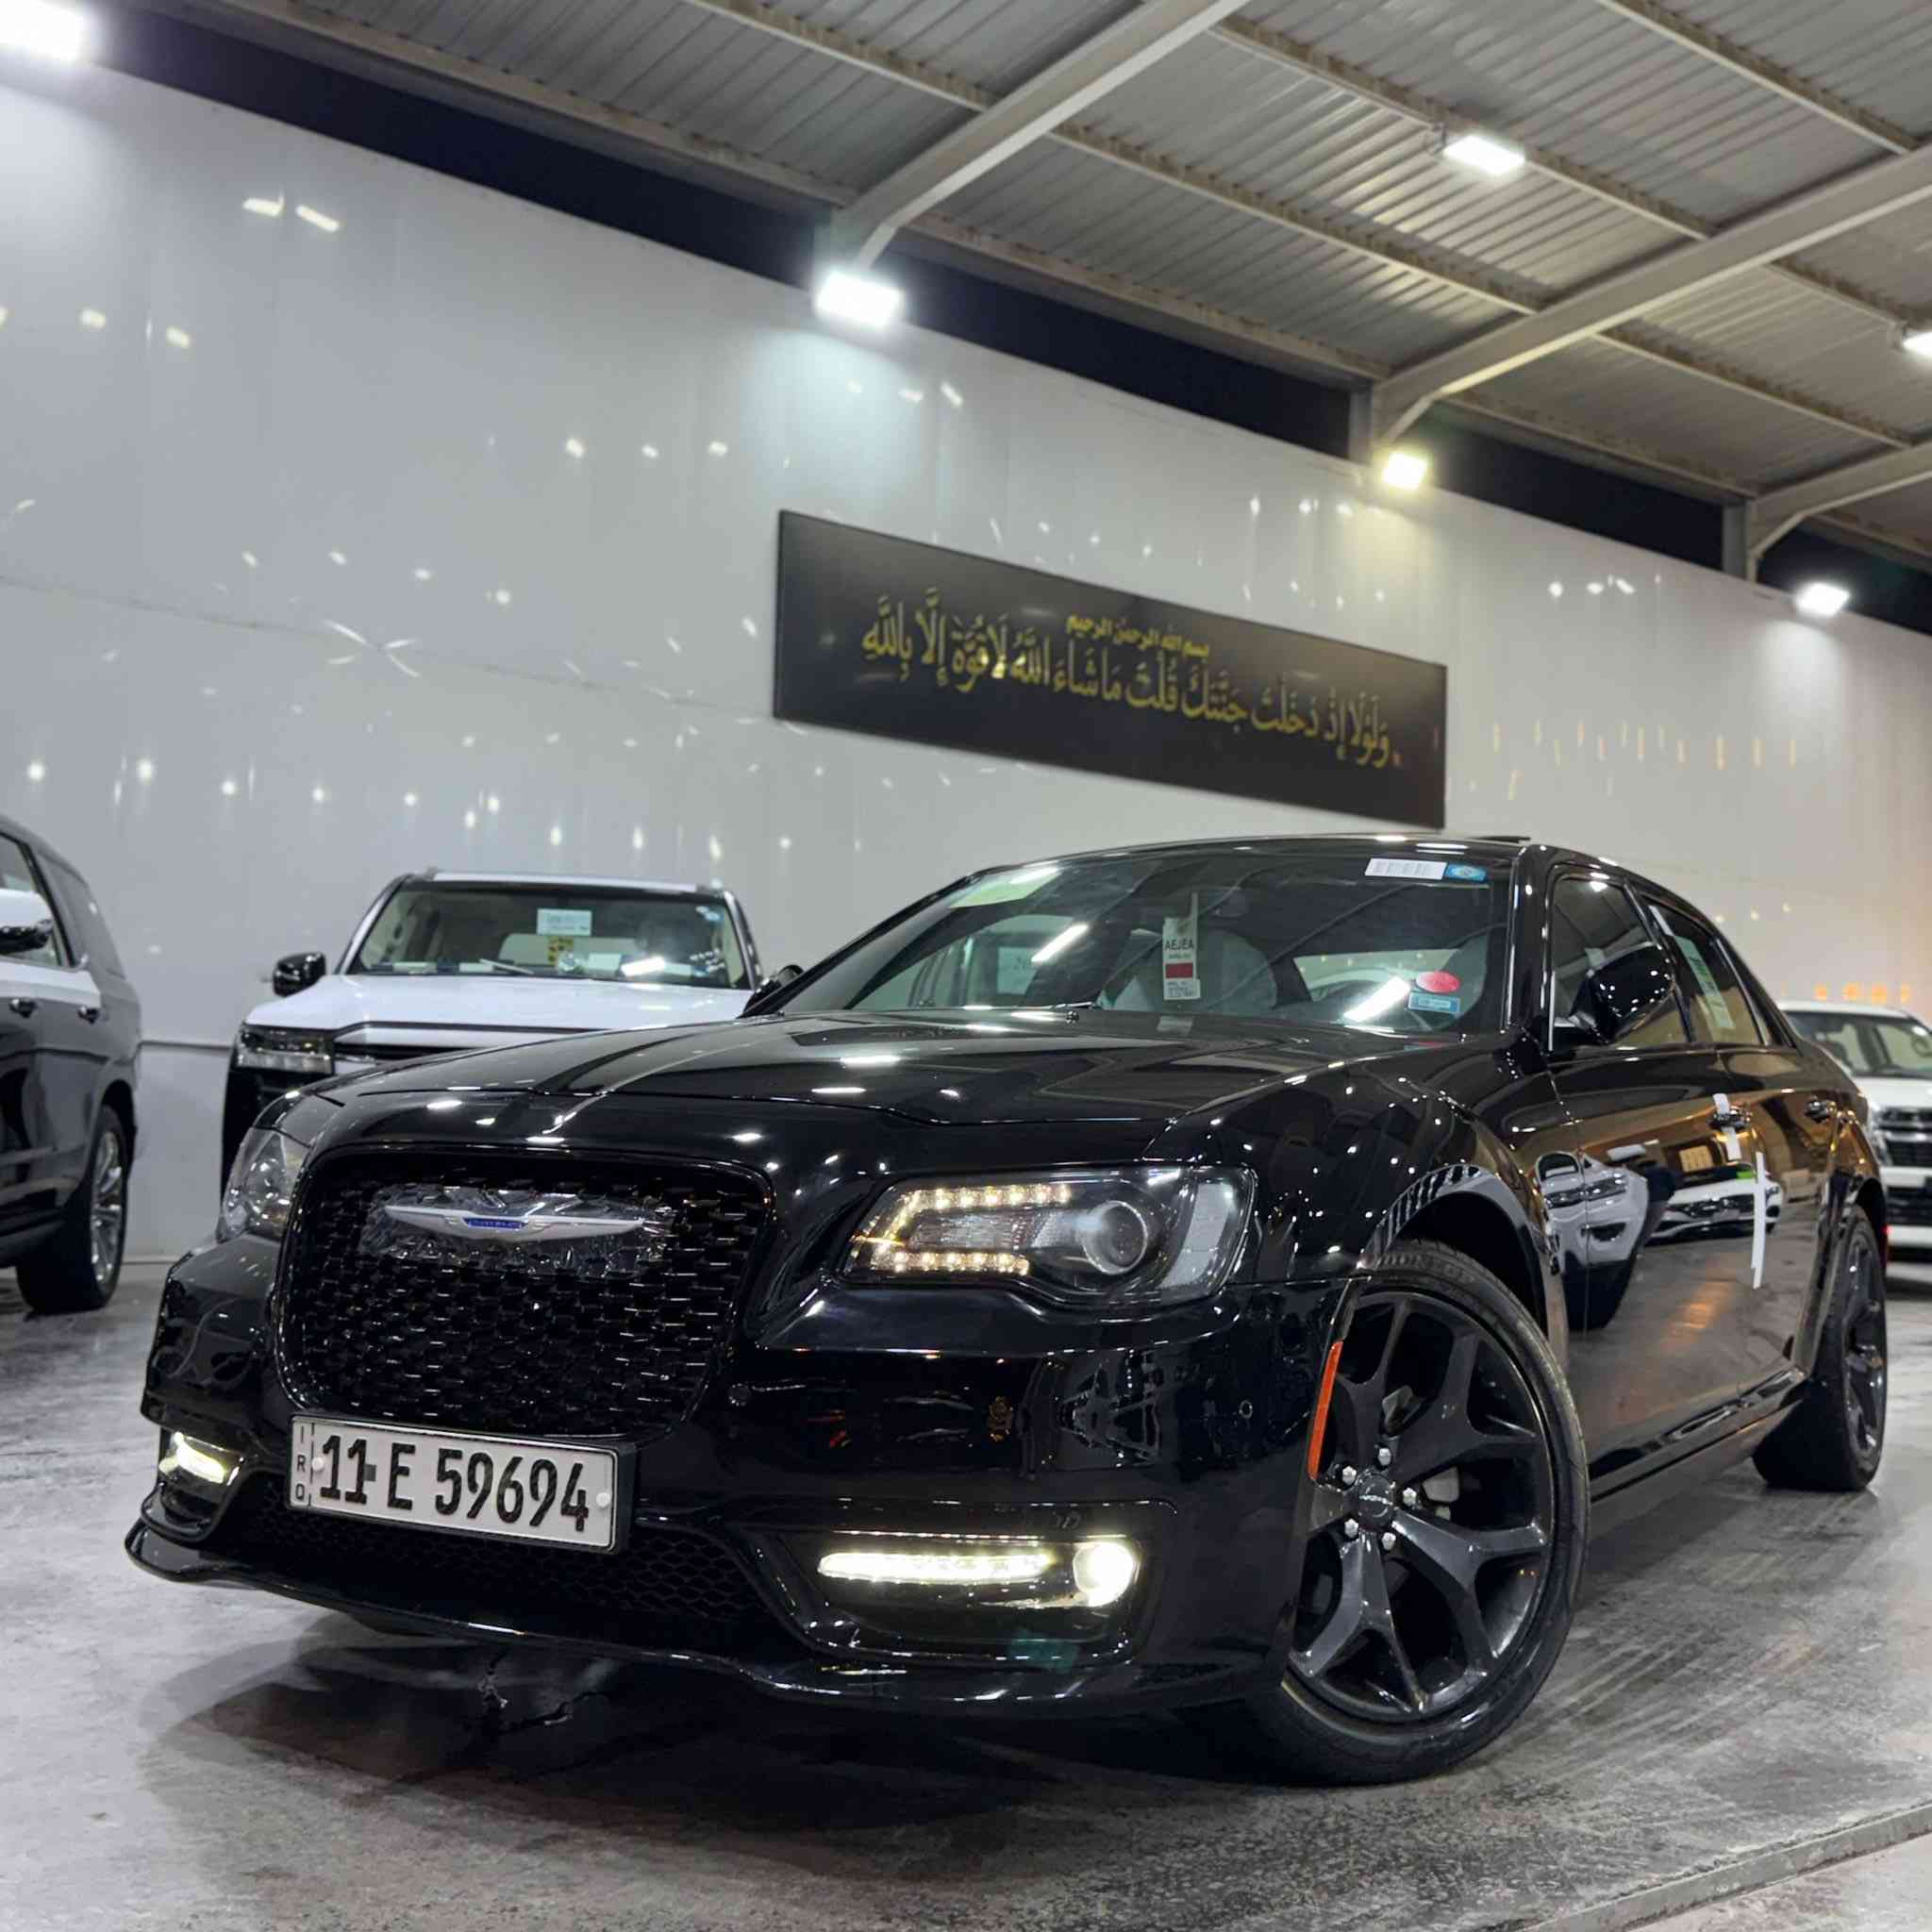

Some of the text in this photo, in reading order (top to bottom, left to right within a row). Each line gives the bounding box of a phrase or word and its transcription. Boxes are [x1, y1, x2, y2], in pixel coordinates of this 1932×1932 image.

[320, 1434, 590, 1533] 11 E 59694
